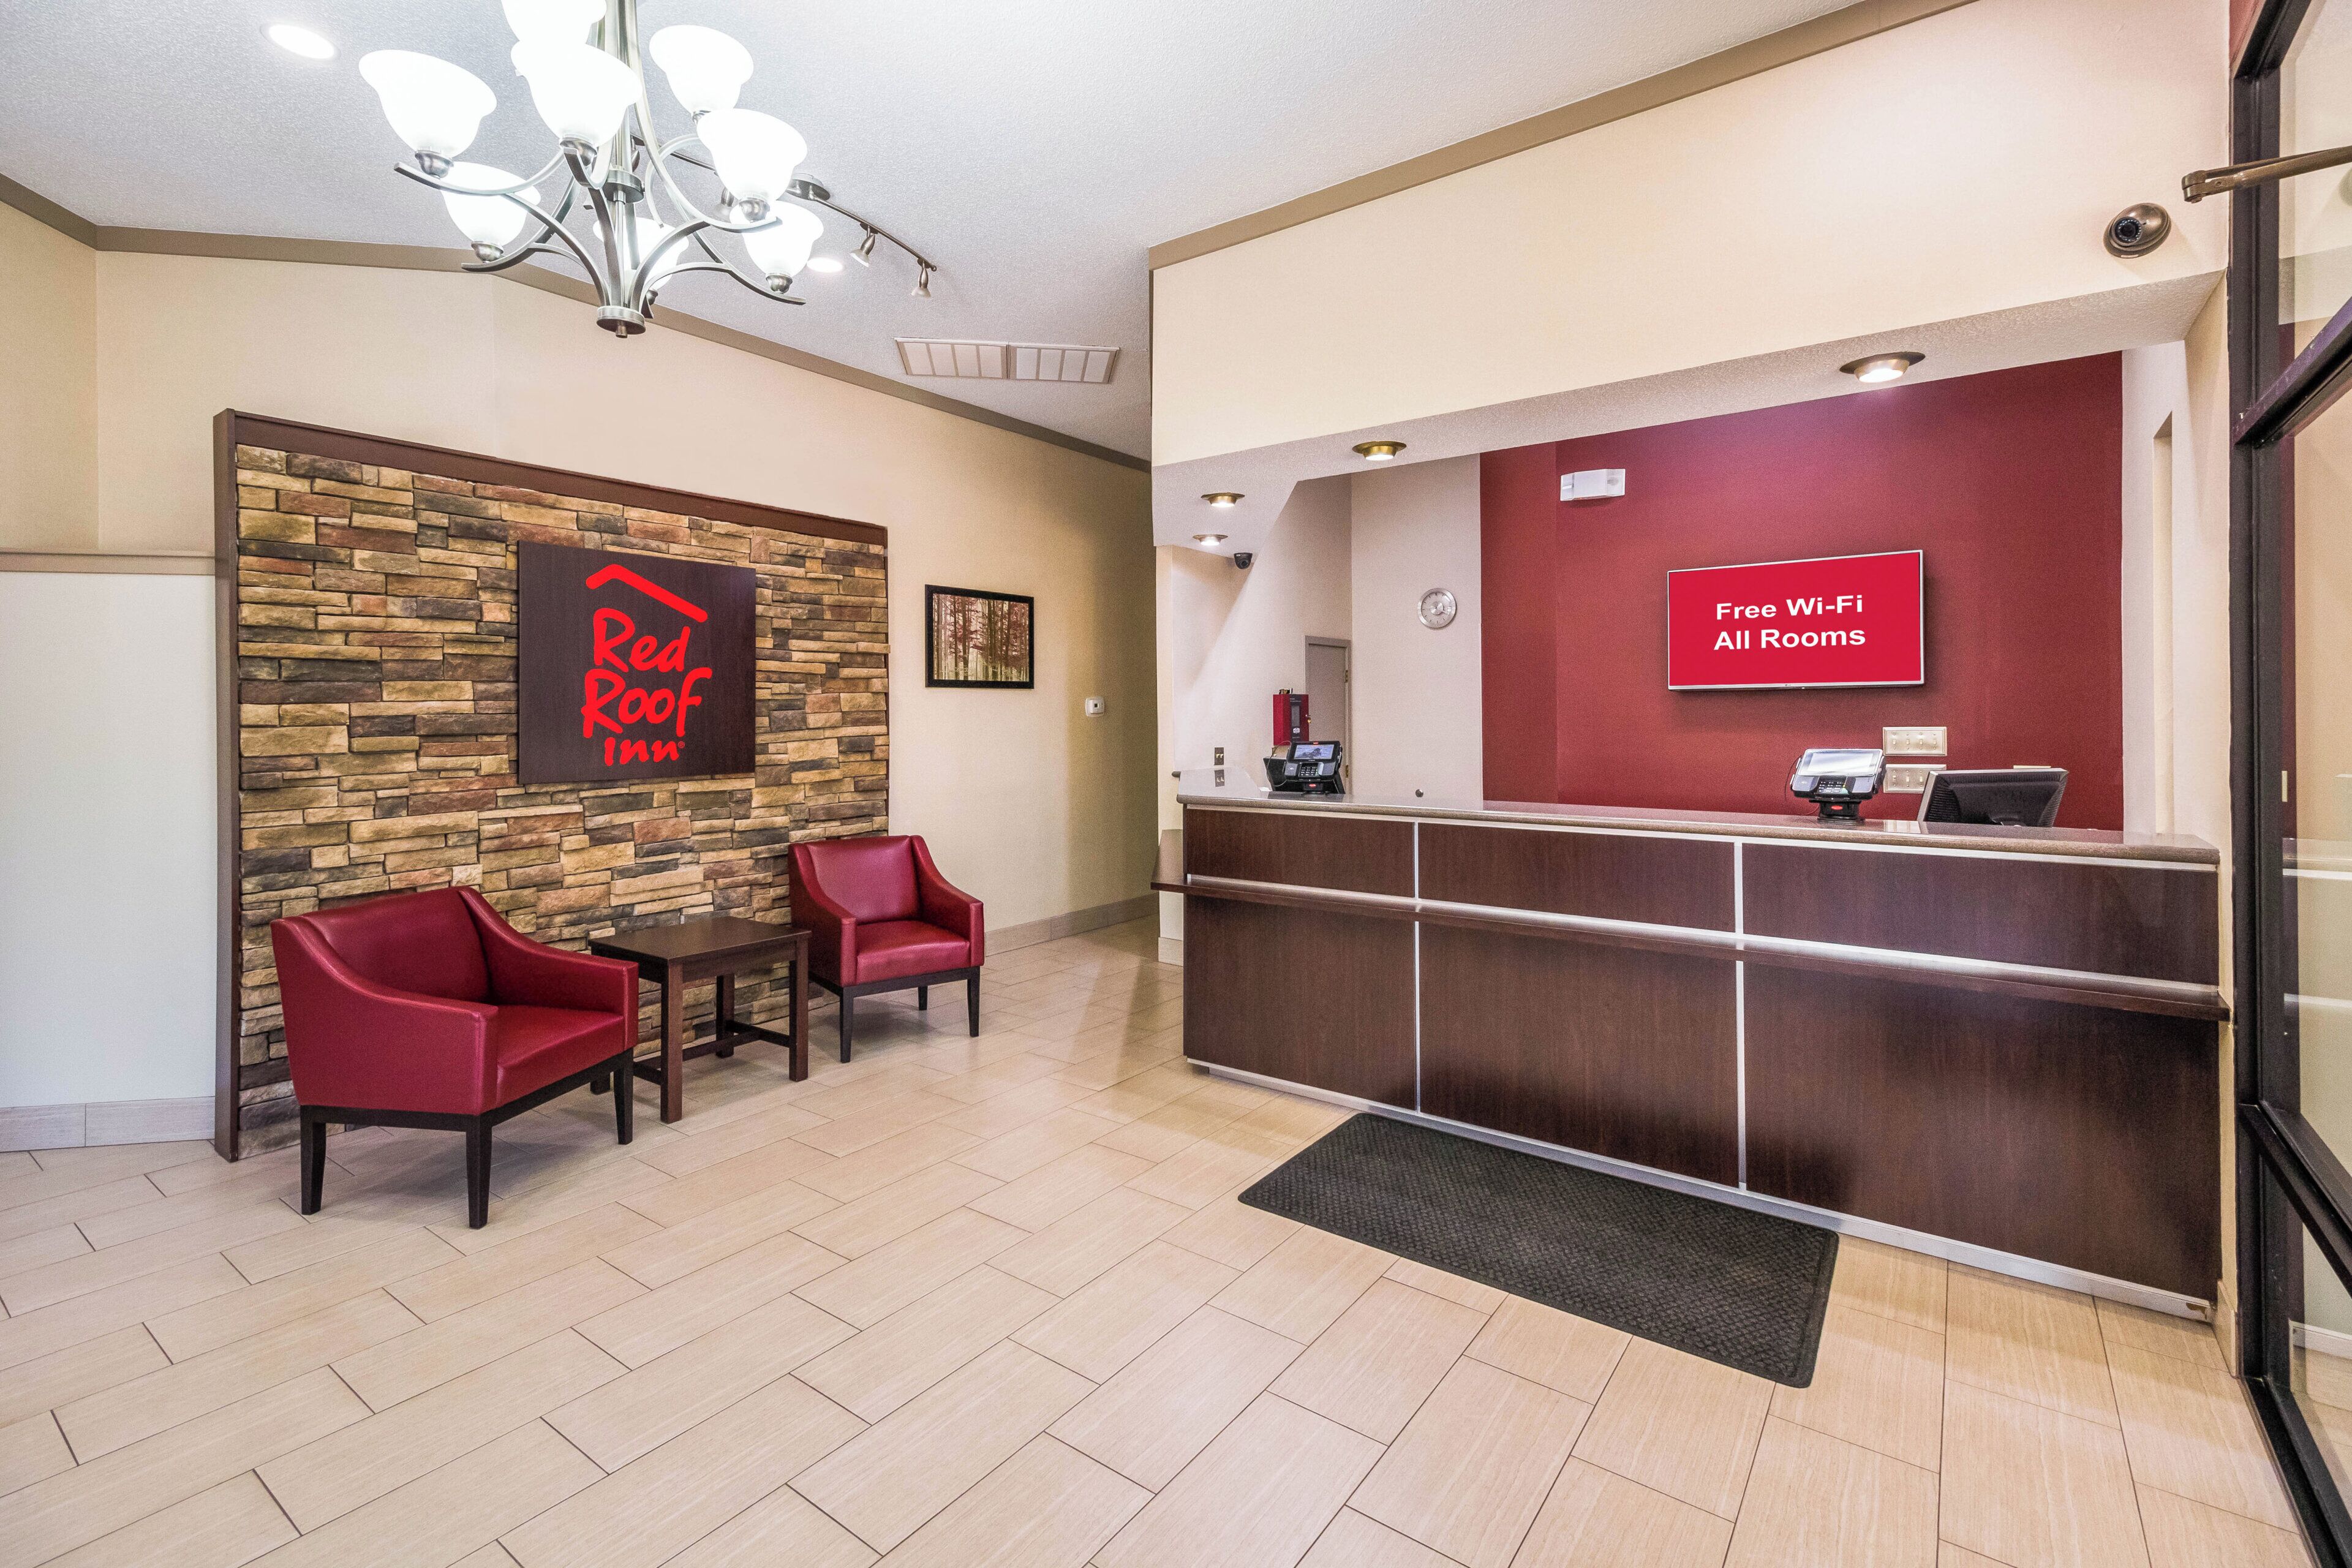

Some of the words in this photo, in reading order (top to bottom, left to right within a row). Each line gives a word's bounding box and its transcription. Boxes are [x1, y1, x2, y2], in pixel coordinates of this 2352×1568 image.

[1716, 603, 1777, 620] Free
[1785, 594, 1863, 616] Wi-Fi
[593, 608, 690, 673] Red
[1714, 630, 1750, 650] All
[1761, 629, 1866, 649] Rooms
[581, 667, 713, 738] Roof
